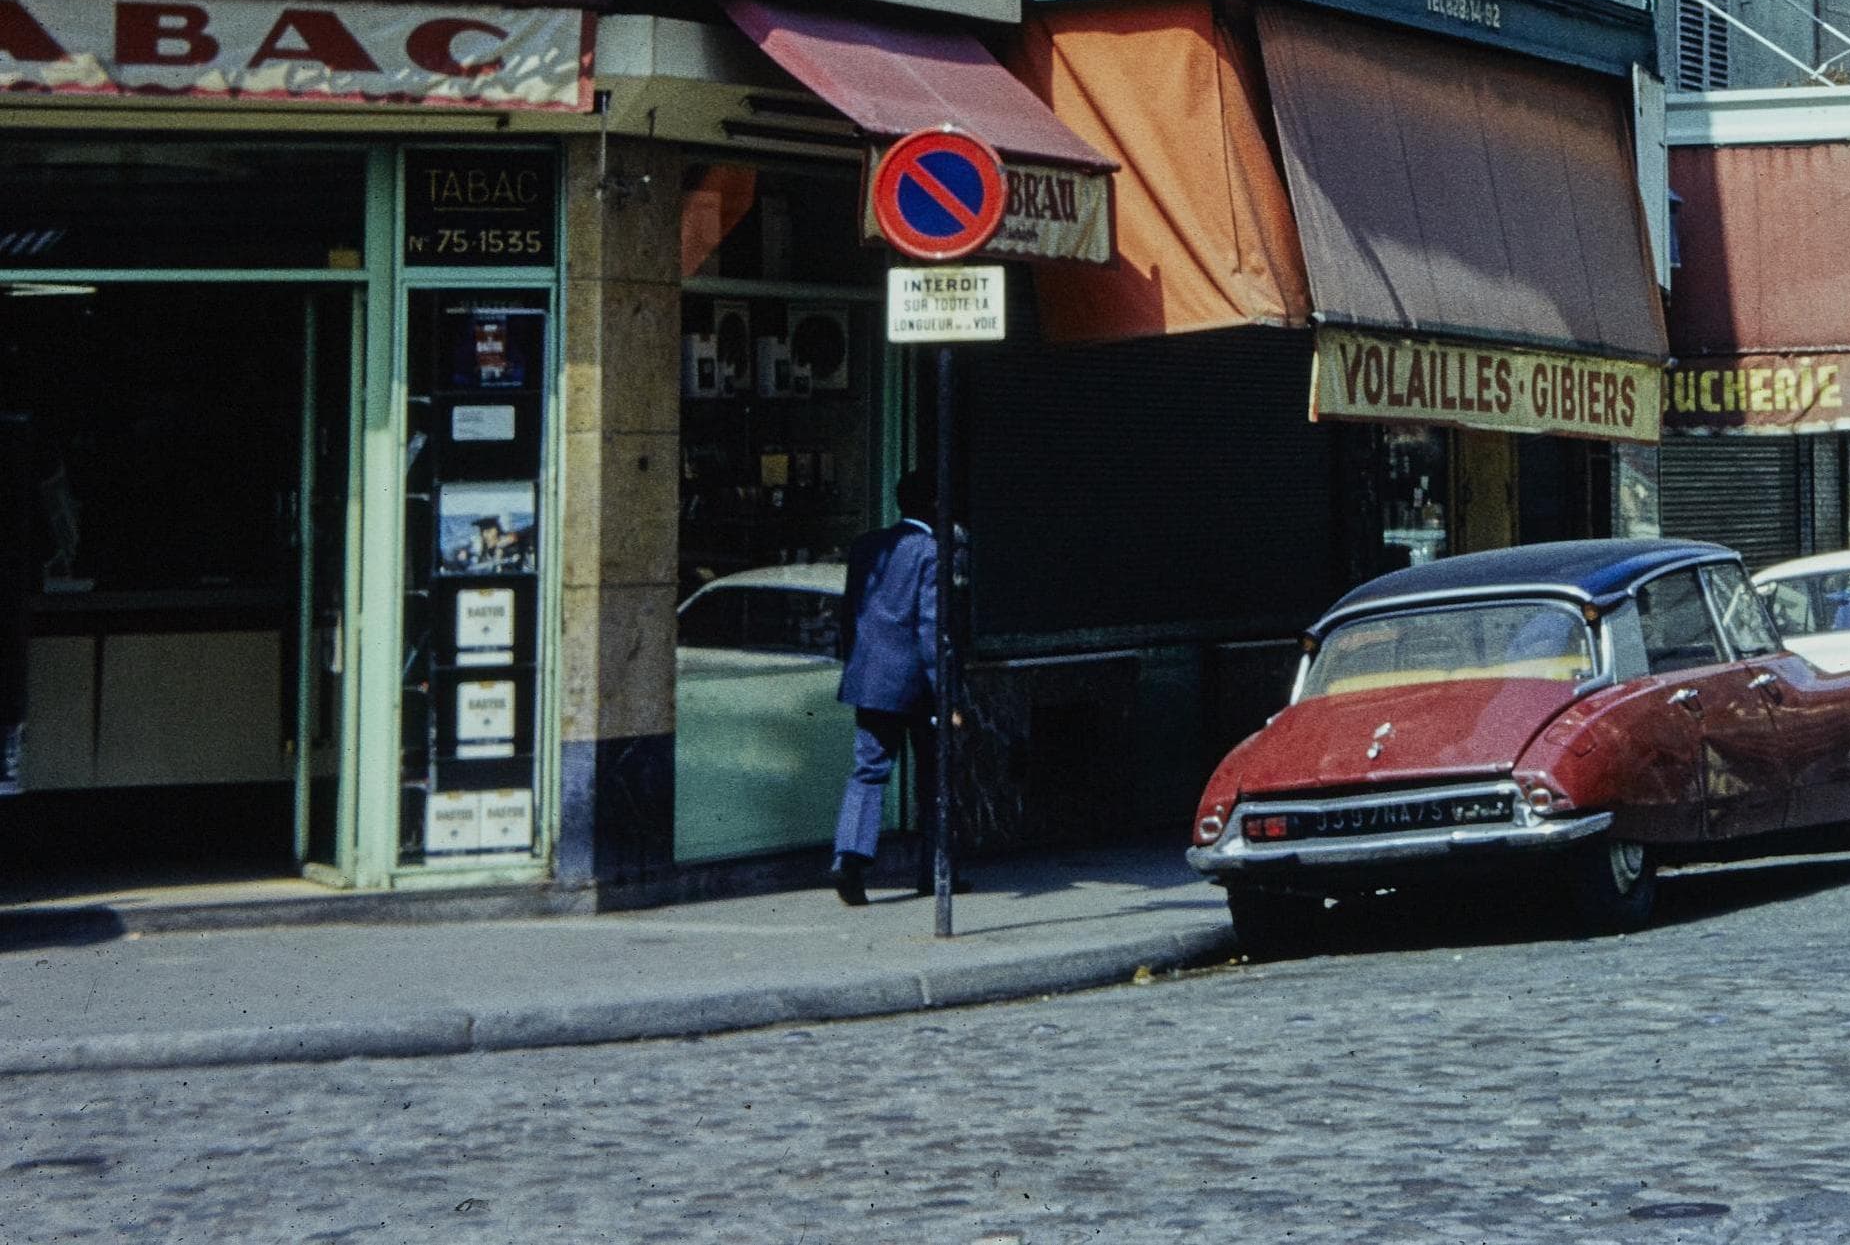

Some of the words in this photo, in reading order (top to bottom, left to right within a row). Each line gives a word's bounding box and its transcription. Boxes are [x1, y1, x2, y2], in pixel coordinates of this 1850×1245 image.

[424, 168, 539, 203] TABAC
[903, 277, 990, 292] INTERDIT
[903, 299, 928, 312] SUR
[934, 298, 970, 312] TOUTE
[975, 298, 989, 310] LA
[893, 316, 954, 332] LONGUEUR
[974, 316, 998, 330] VOIE
[1338, 342, 1511, 414] VOLAILLES
[1531, 360, 1636, 428] GIBIERS
